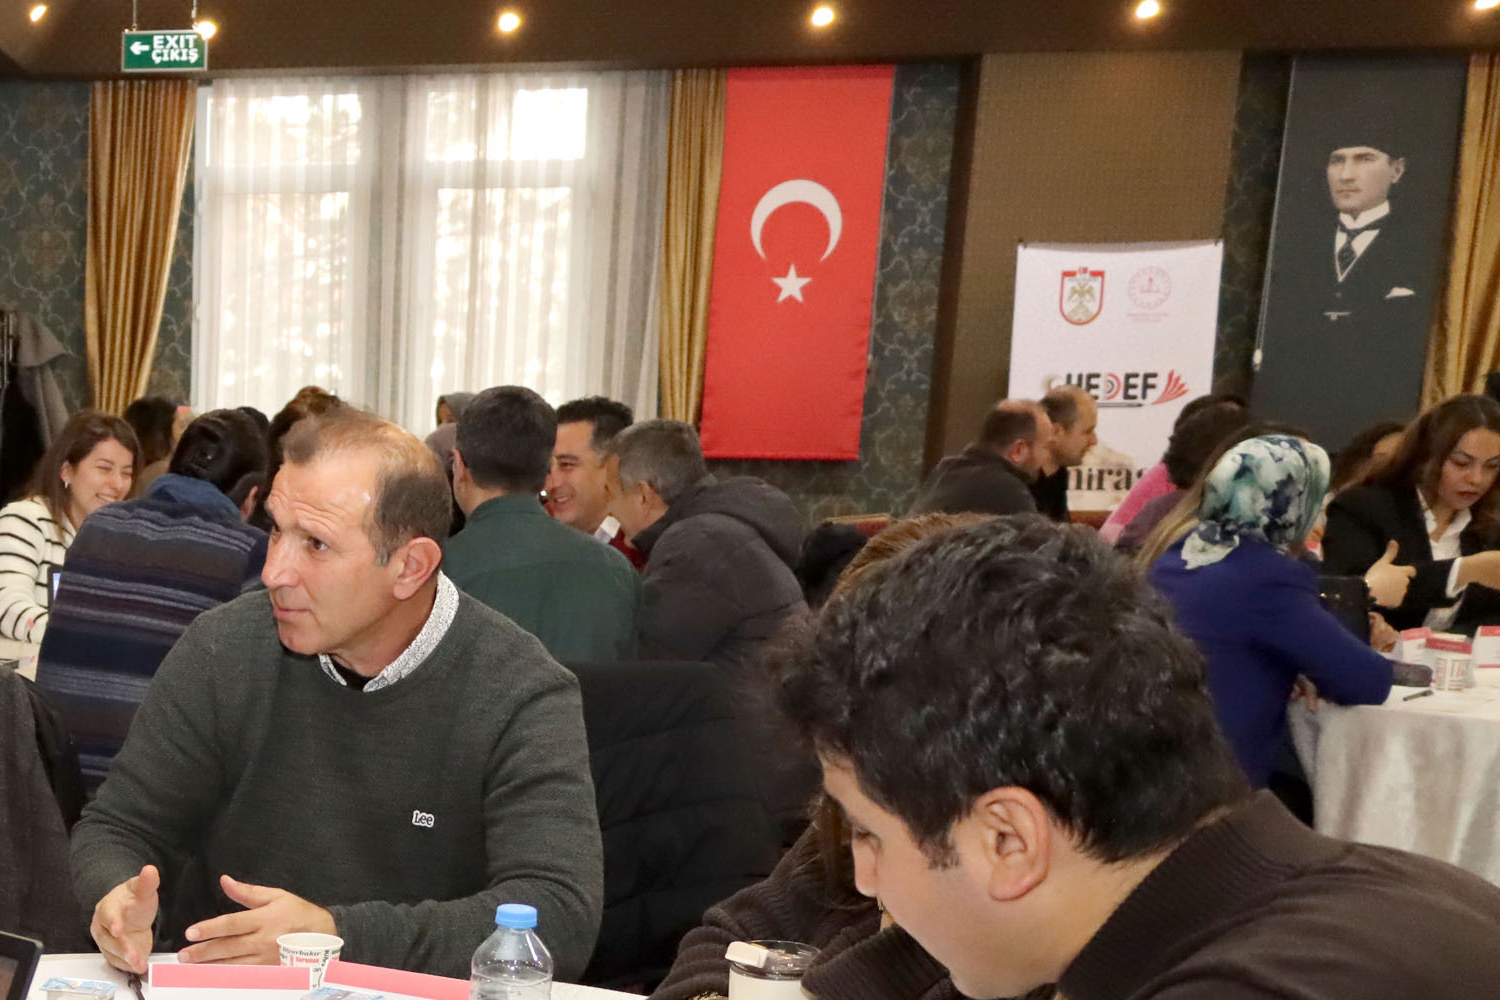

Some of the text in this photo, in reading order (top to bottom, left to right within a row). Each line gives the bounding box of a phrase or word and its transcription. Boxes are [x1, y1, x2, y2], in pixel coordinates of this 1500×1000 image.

[153, 34, 198, 49] EXIT
[151, 48, 199, 64] ÇIKIŞ
[412, 809, 435, 828] Lee
